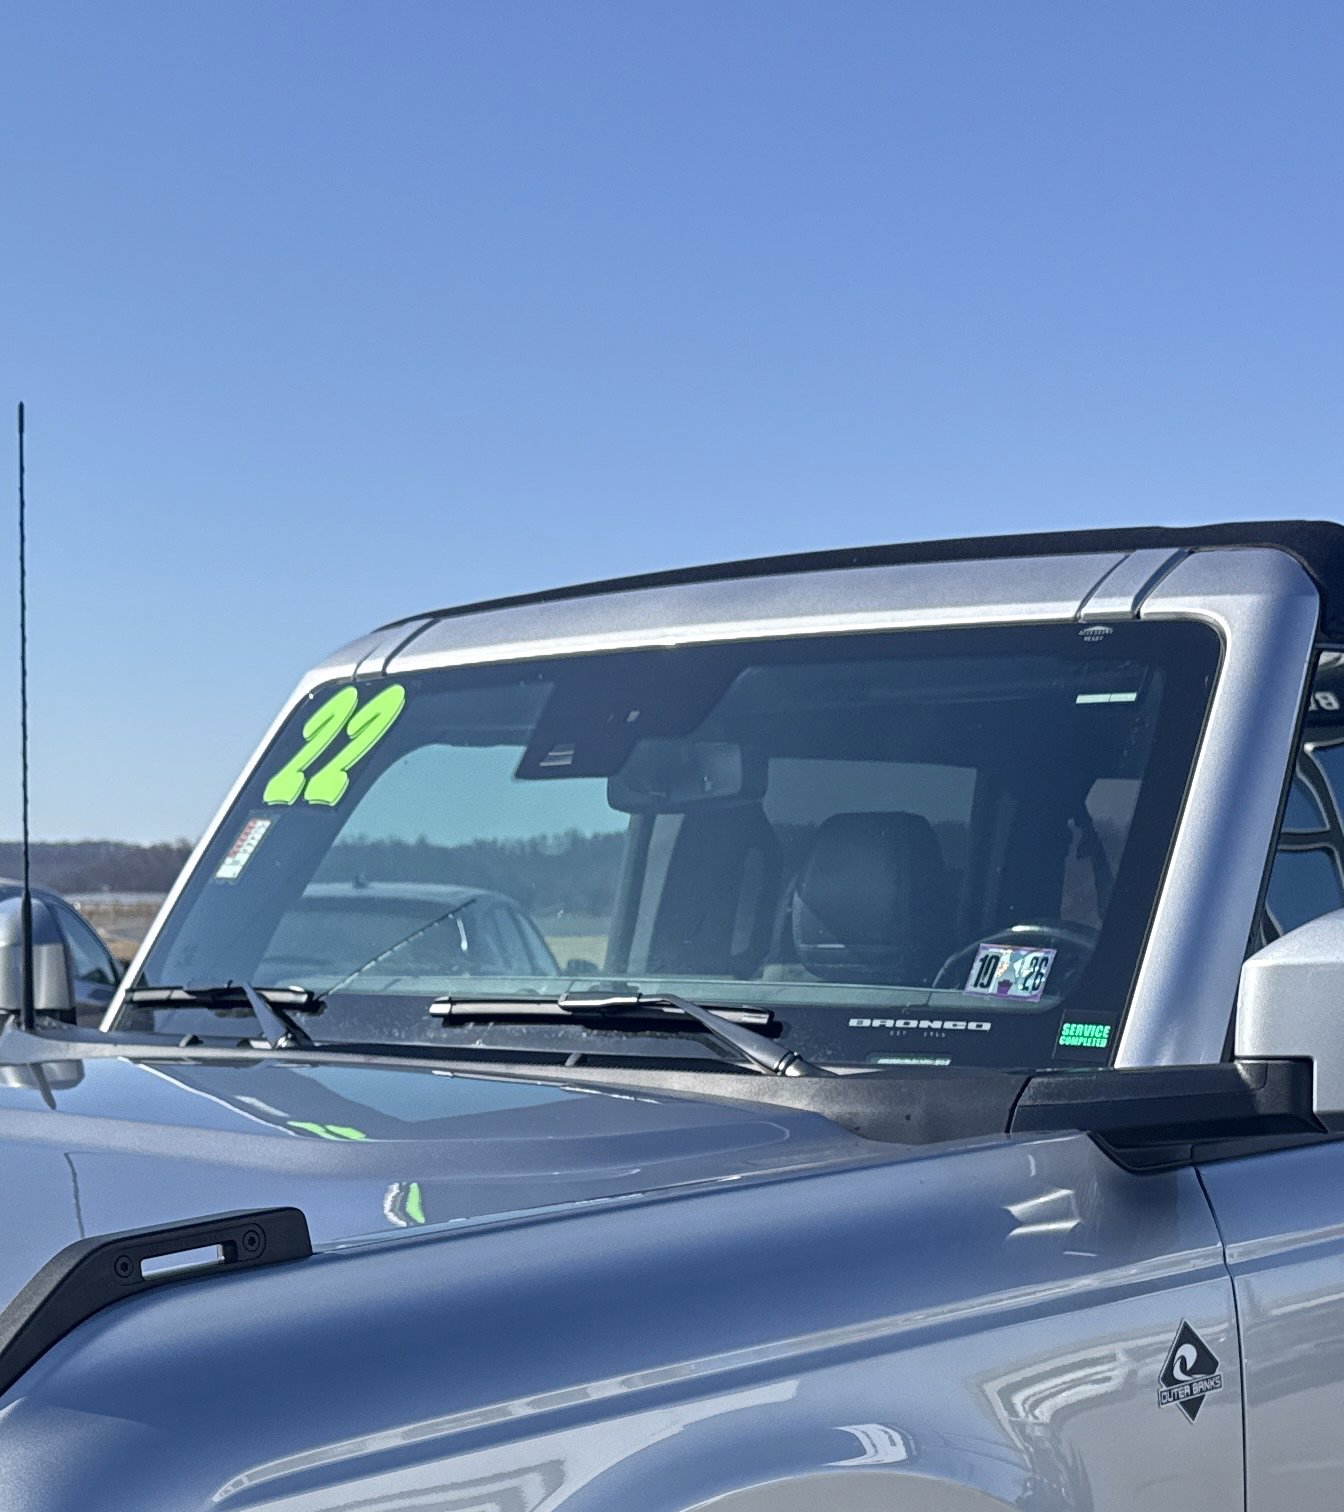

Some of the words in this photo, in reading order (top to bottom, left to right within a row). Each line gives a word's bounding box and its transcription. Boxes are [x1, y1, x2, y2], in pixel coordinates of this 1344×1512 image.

[263, 684, 405, 806] 22
[848, 1018, 992, 1031] BRONCO
[1061, 1023, 1111, 1038] SERVICE
[1059, 1035, 1108, 1048] COMPLETED
[1161, 1384, 1191, 1404] OUTER
[1192, 1374, 1221, 1395] BANKS
